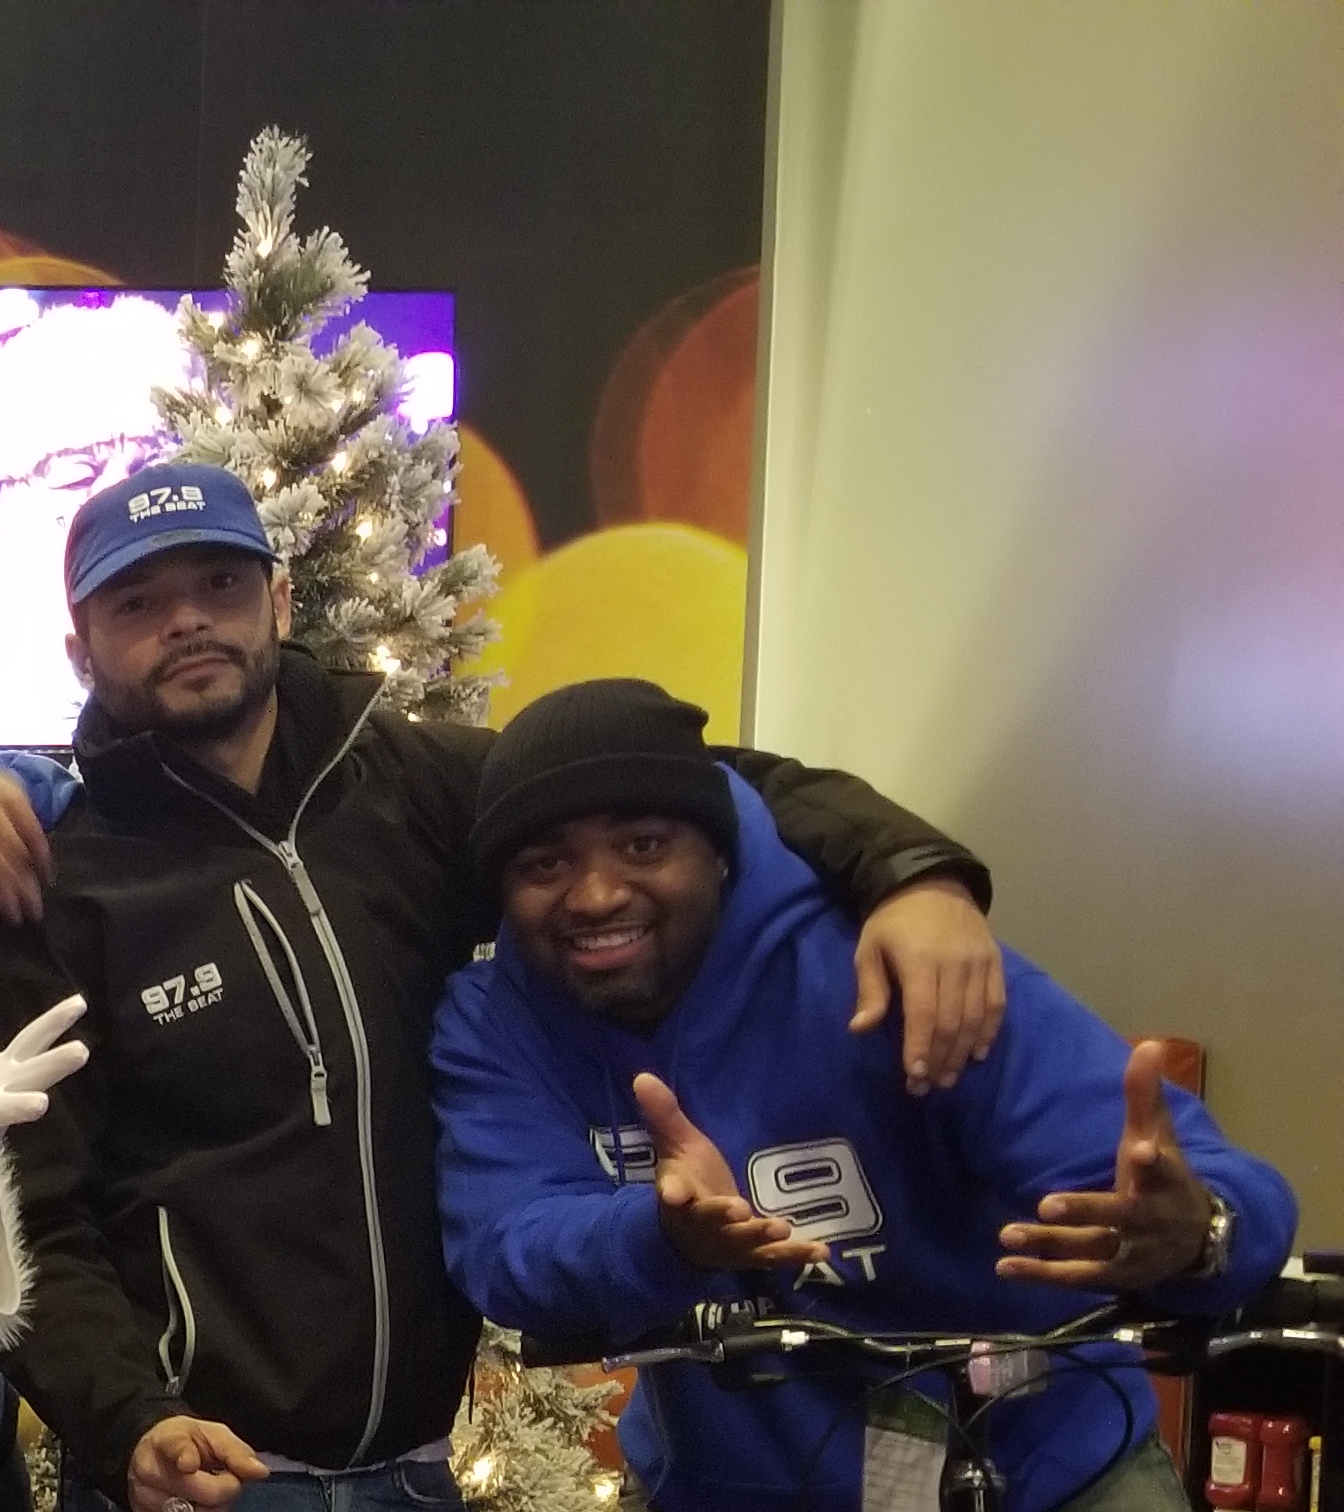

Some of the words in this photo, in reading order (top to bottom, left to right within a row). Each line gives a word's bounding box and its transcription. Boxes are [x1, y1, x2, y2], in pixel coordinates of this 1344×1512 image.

[128, 486, 204, 515] 97.9
[129, 505, 162, 523] THE
[164, 500, 207, 512] BEAT
[140, 962, 223, 1015] 97.9
[152, 1004, 185, 1026] THE
[187, 987, 224, 1013] BEAT
